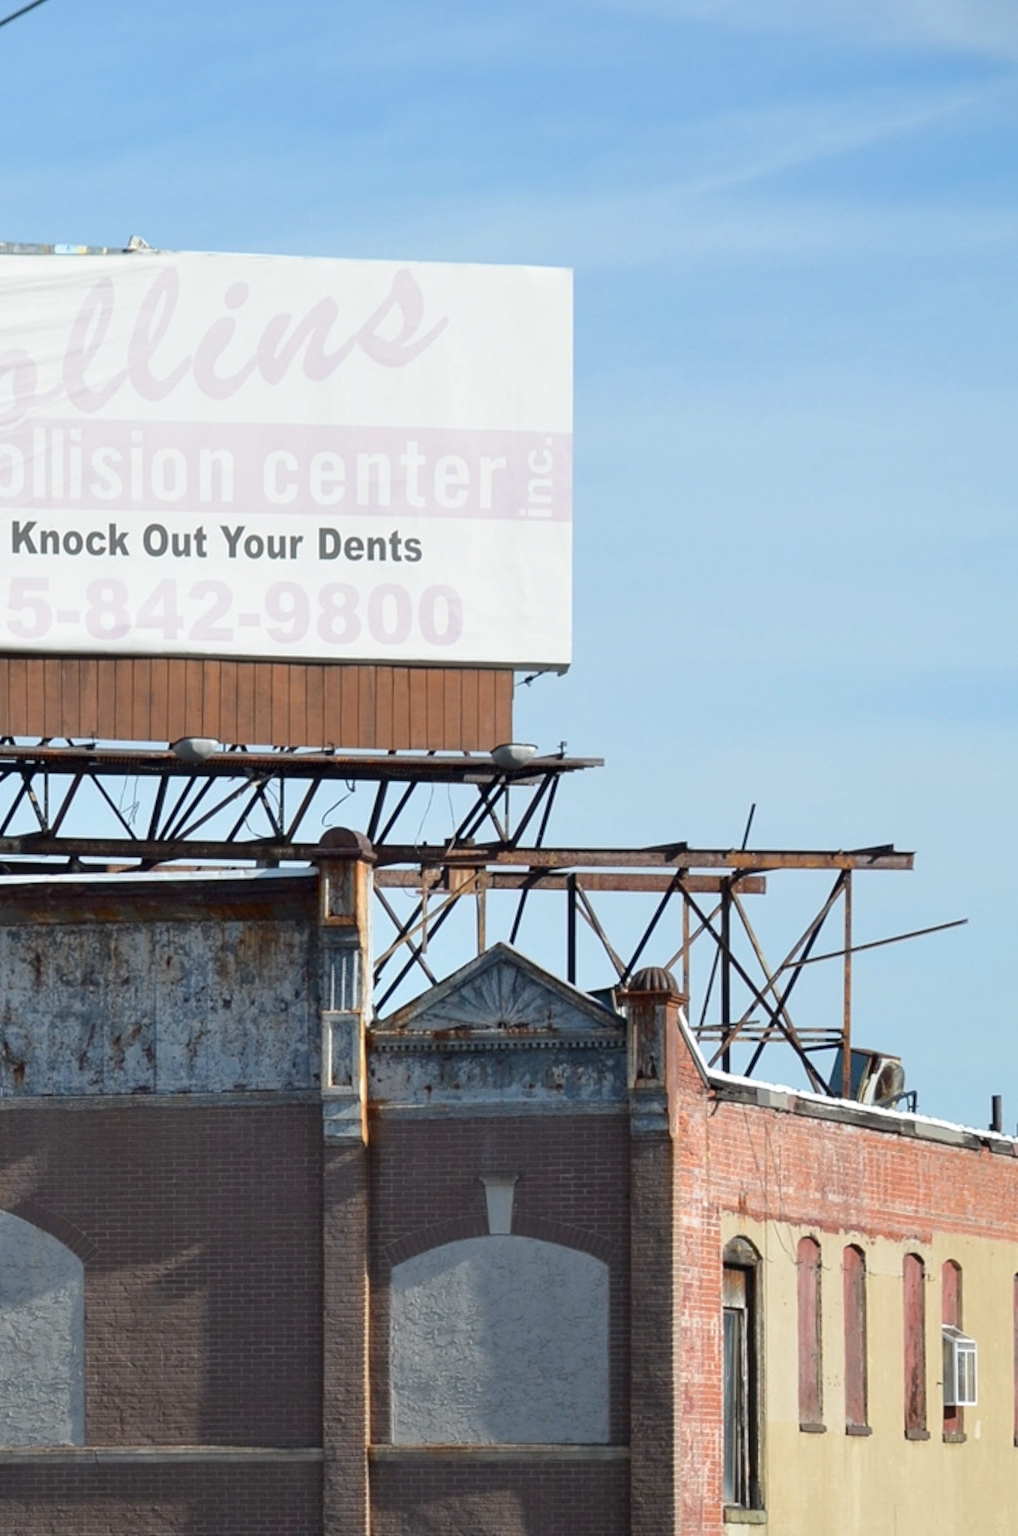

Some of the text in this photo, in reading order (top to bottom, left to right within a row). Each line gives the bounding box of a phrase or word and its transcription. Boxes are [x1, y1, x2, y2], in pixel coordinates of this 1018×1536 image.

[262, 440, 507, 511] center
[11, 520, 129, 557] Knock
[143, 523, 207, 559] Out
[221, 525, 303, 562] Your
[317, 527, 423, 564] Dents
